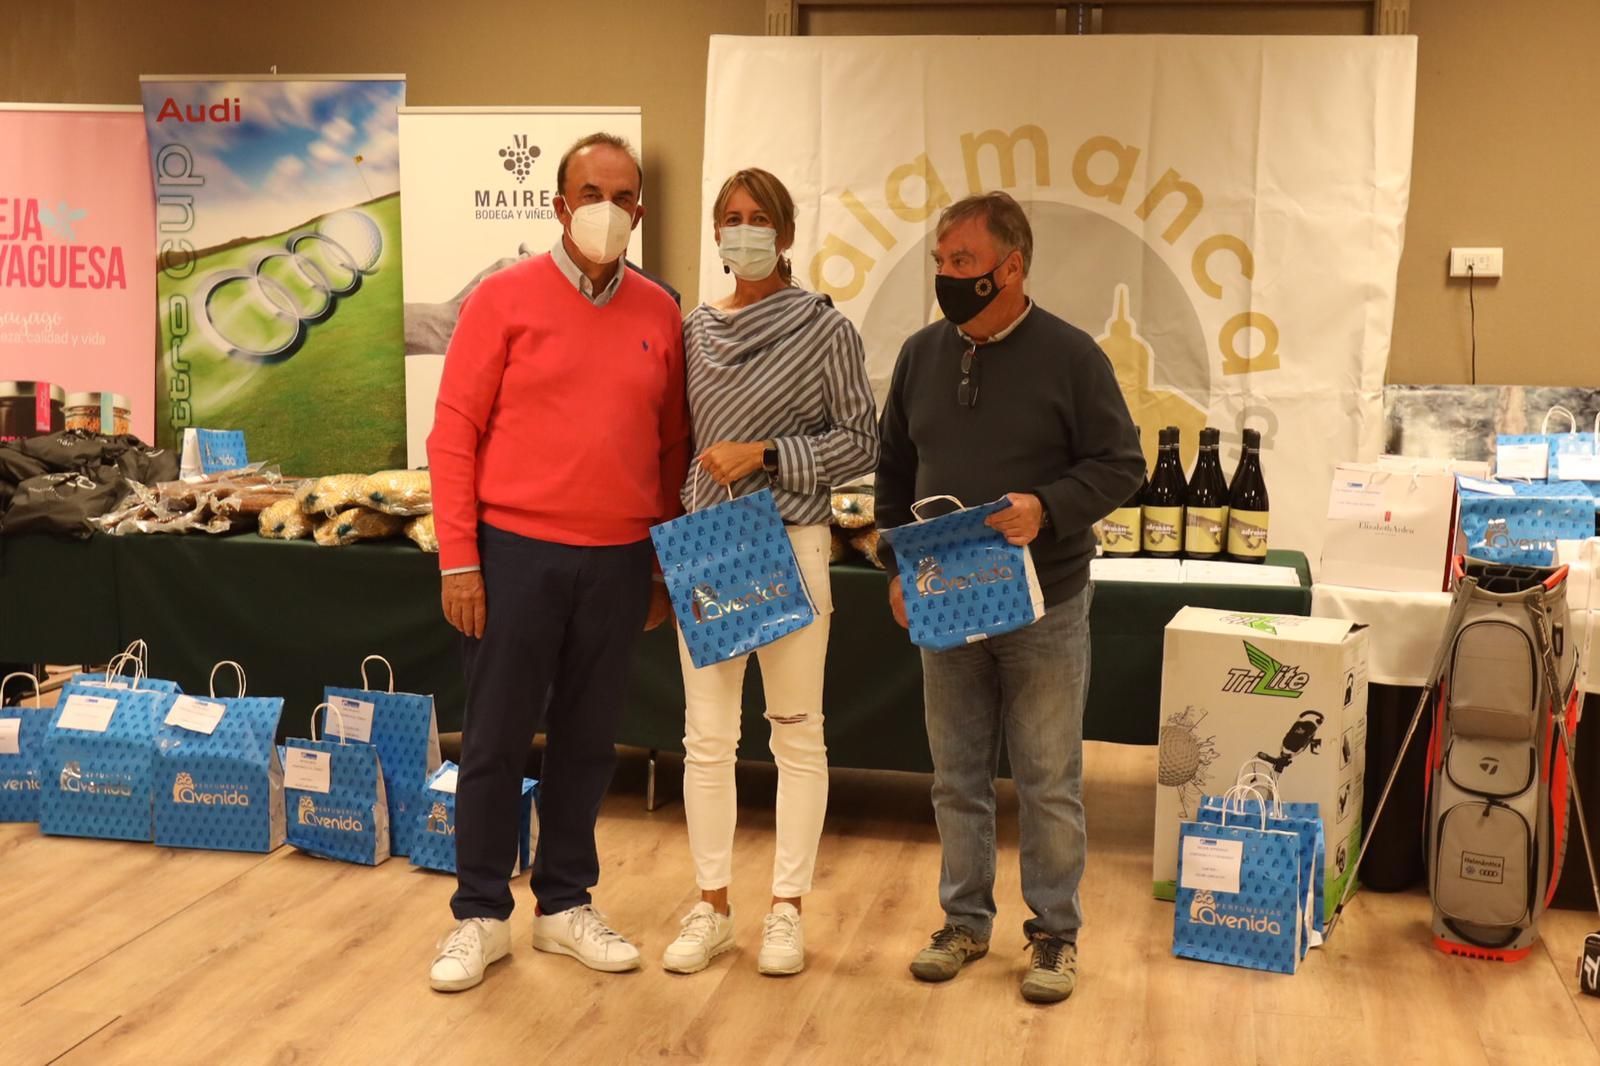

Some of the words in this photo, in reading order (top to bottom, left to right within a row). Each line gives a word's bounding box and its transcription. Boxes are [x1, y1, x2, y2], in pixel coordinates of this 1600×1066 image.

[156, 98, 242, 123] Audi
[474, 189, 559, 207] MAIRE
[156, 143, 205, 280] cup
[475, 209, 514, 221] BODEGA
[516, 209, 523, 221] Y
[926, 561, 1014, 595] avenida
[66, 776, 132, 797] avenida
[180, 788, 249, 806] avenida
[304, 811, 363, 832] avenida
[1199, 908, 1281, 935] avenida
